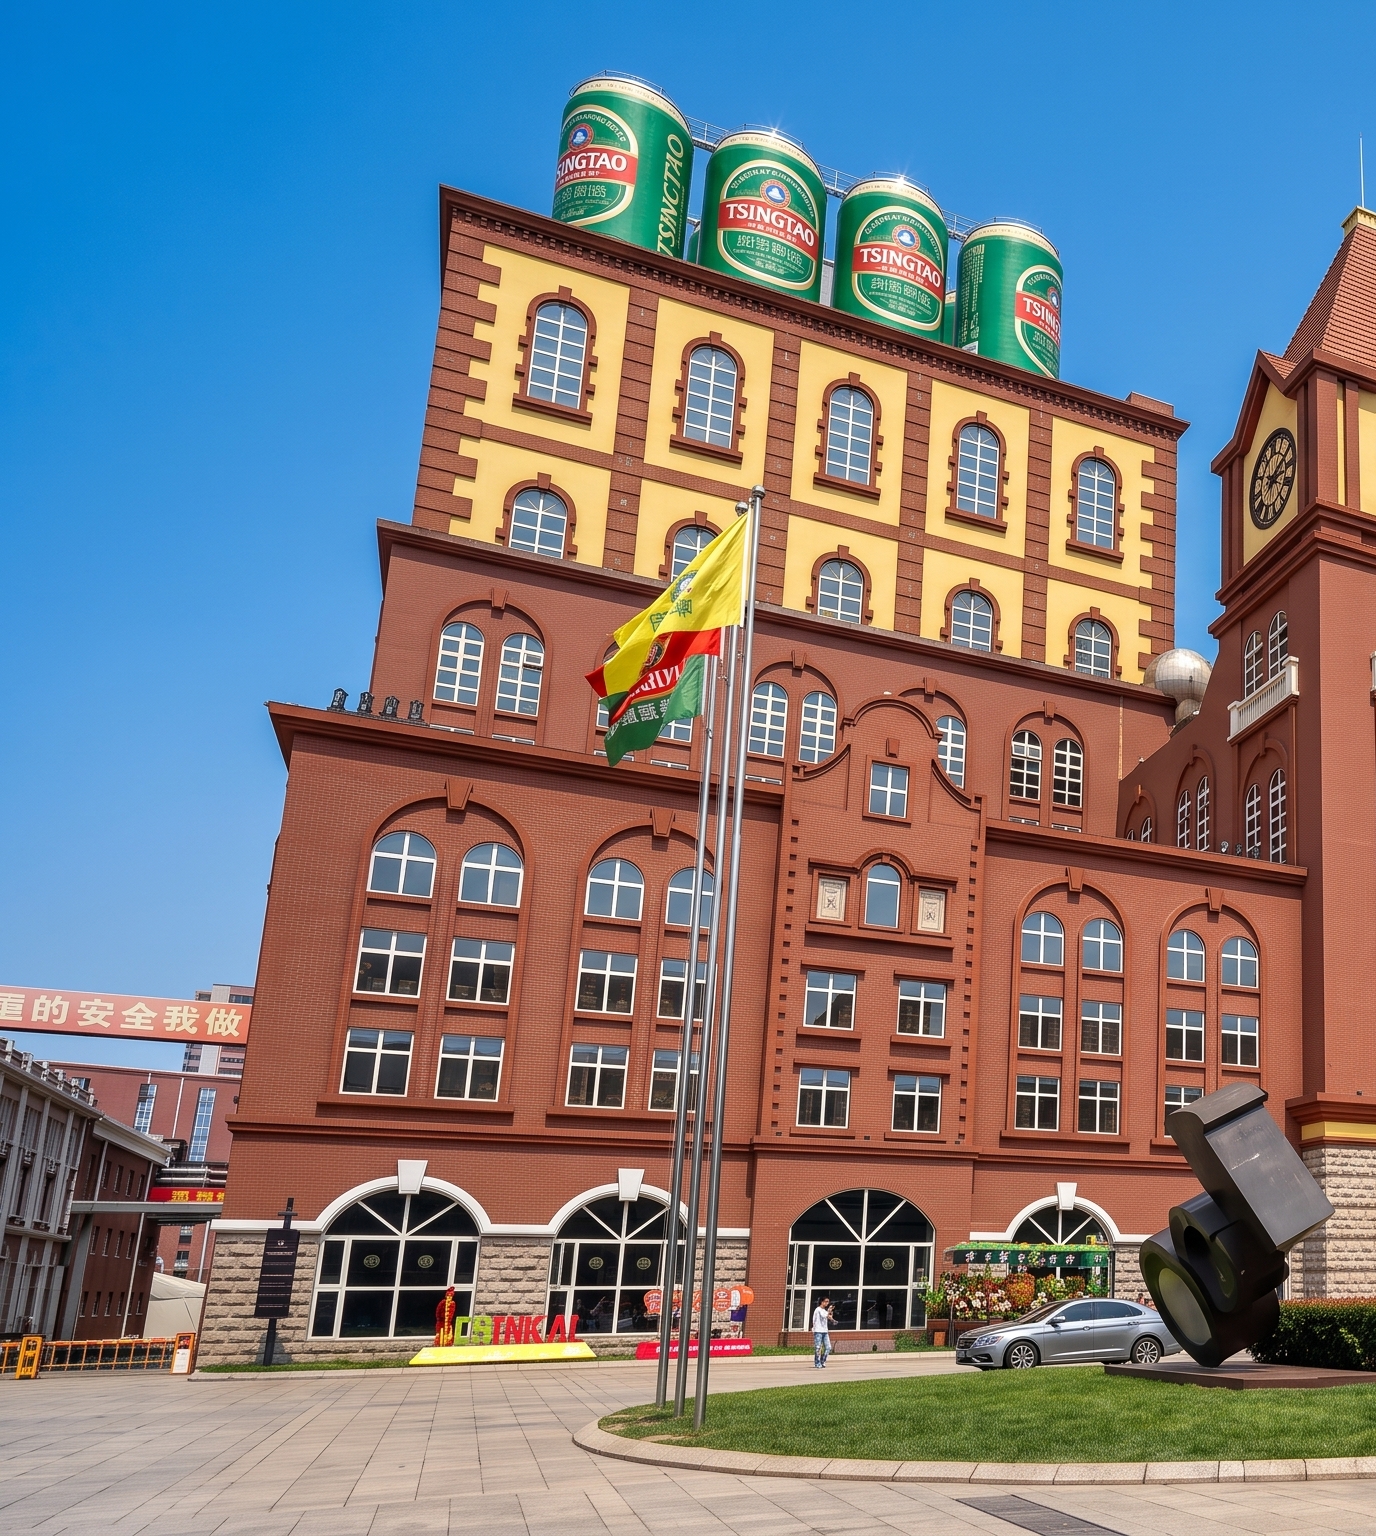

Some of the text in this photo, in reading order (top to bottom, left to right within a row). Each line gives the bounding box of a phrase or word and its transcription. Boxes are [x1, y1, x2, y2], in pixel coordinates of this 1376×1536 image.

[556, 152, 627, 181] SINGTAO
[726, 203, 815, 247] TSINGTAO
[860, 248, 941, 288] TSINGTAO
